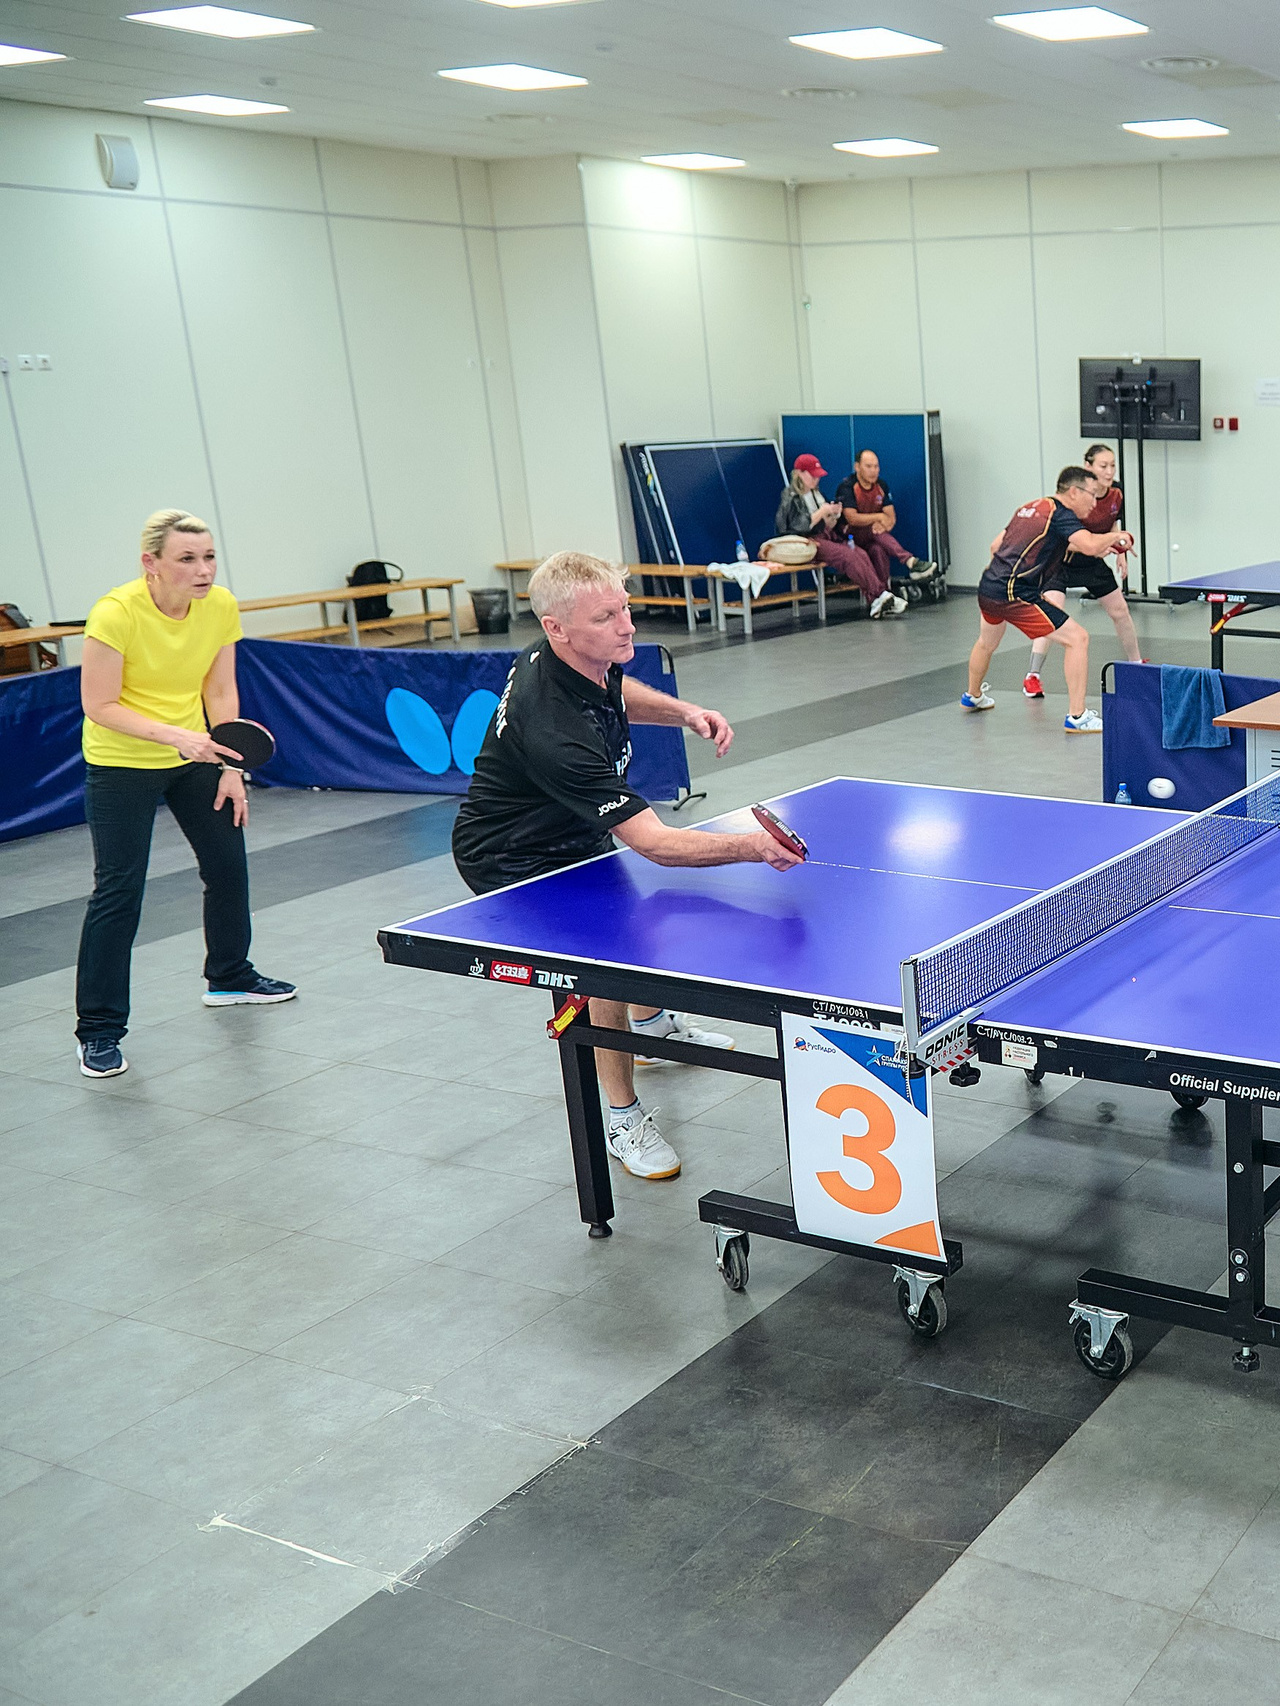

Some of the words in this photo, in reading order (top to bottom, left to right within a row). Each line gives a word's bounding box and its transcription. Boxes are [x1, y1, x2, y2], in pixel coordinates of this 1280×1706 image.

[598, 795, 630, 817] JOOLA
[535, 969, 579, 990] DHS
[924, 1022, 966, 1061] DONIC
[1169, 1072, 1219, 1092] Official
[815, 1084, 902, 1215] 3
